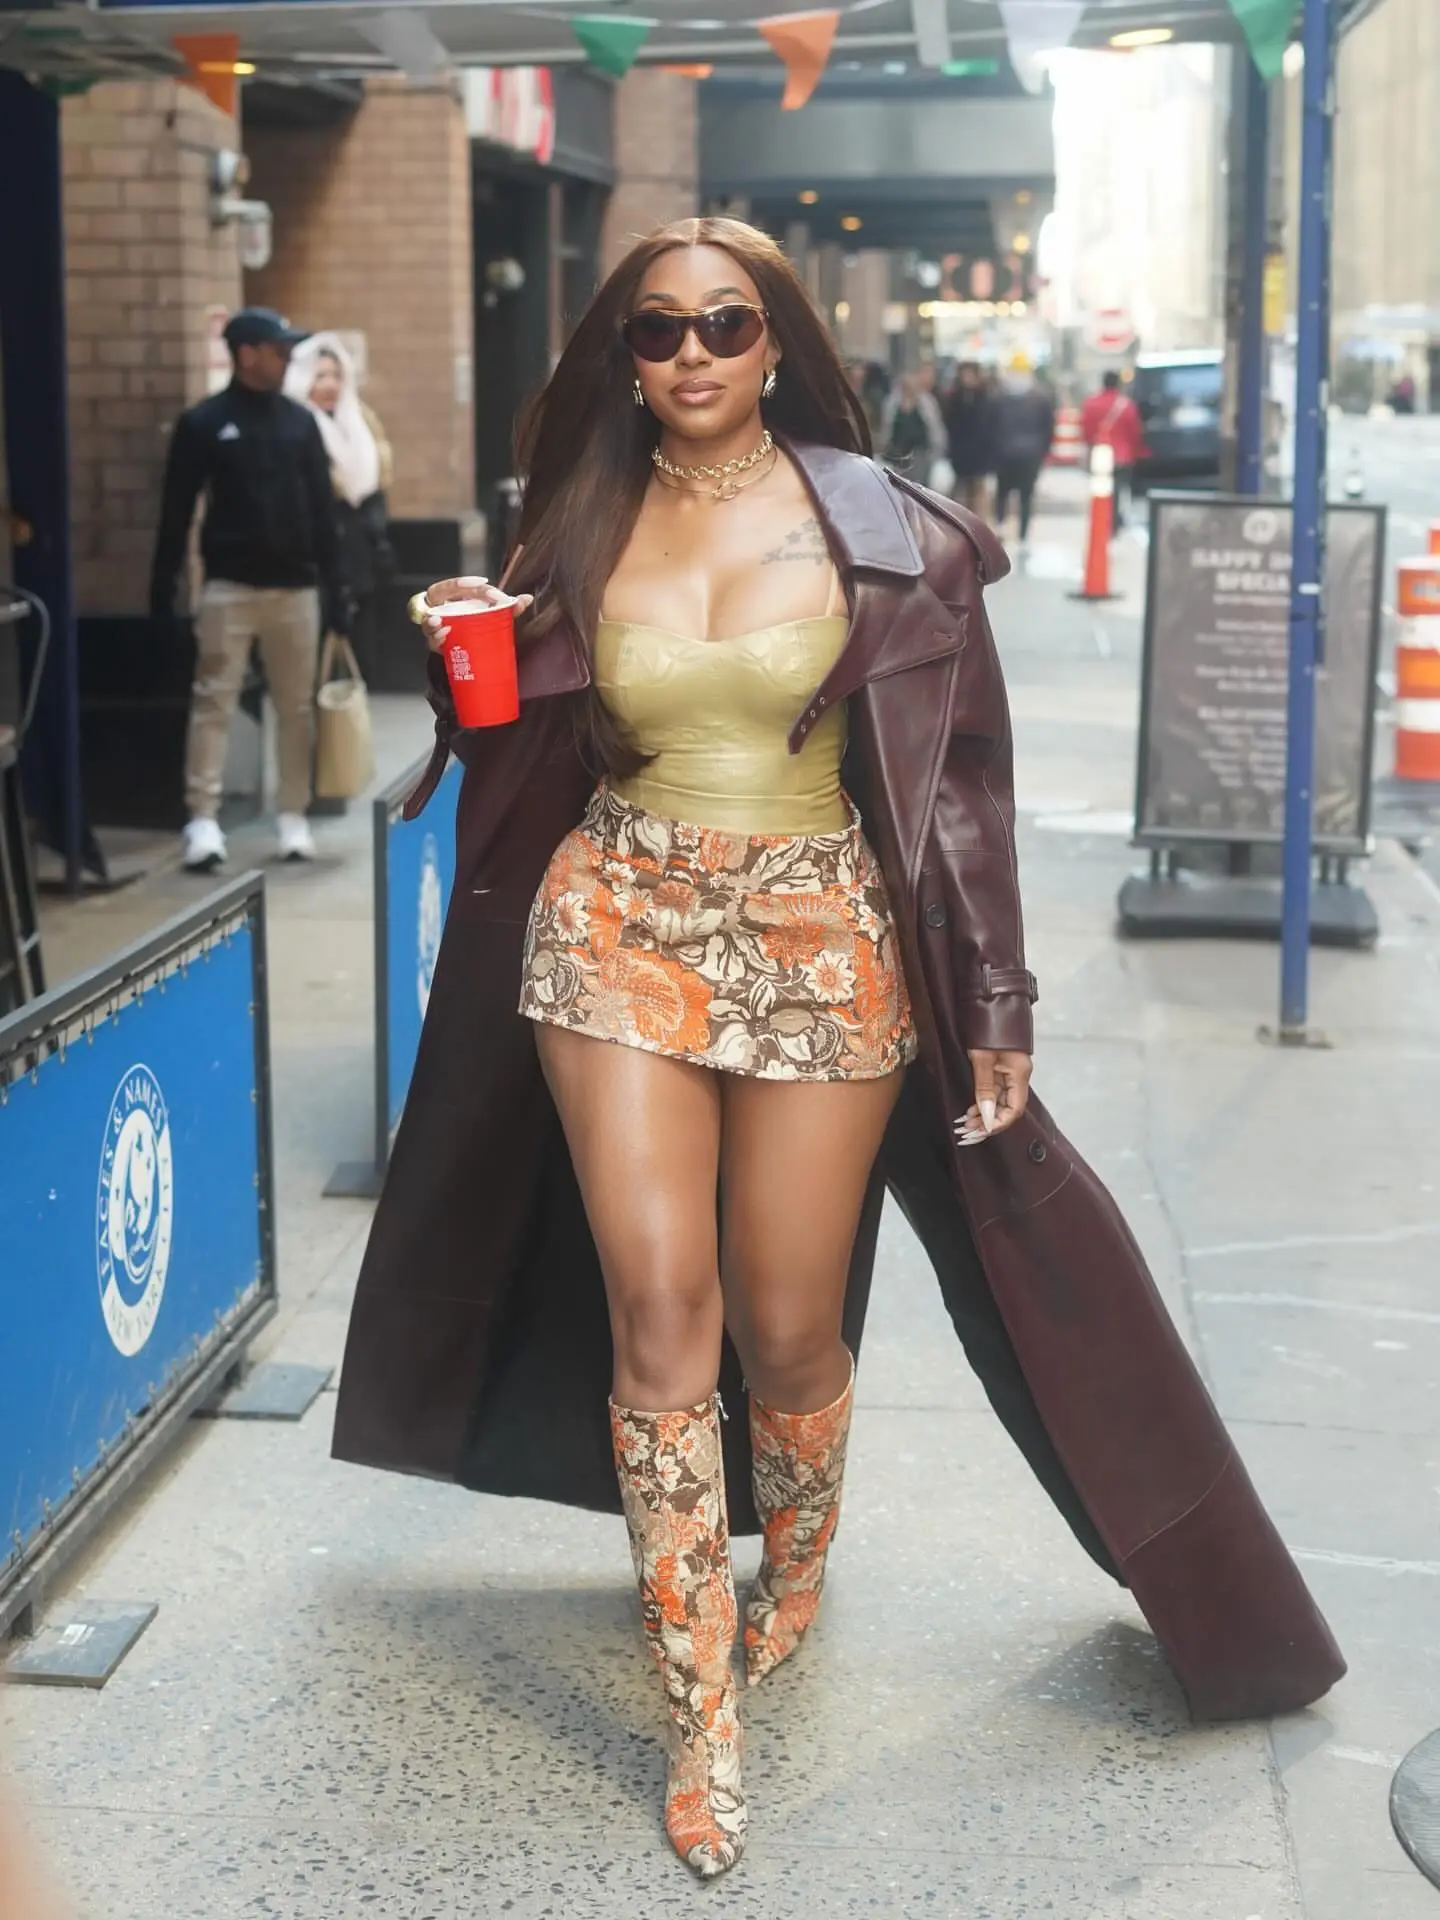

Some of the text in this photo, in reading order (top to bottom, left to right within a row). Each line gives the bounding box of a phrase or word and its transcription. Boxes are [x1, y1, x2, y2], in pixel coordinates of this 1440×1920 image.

[1215, 571, 1291, 593] SPECIA
[98, 1076, 162, 1278] FACES & NAMES
